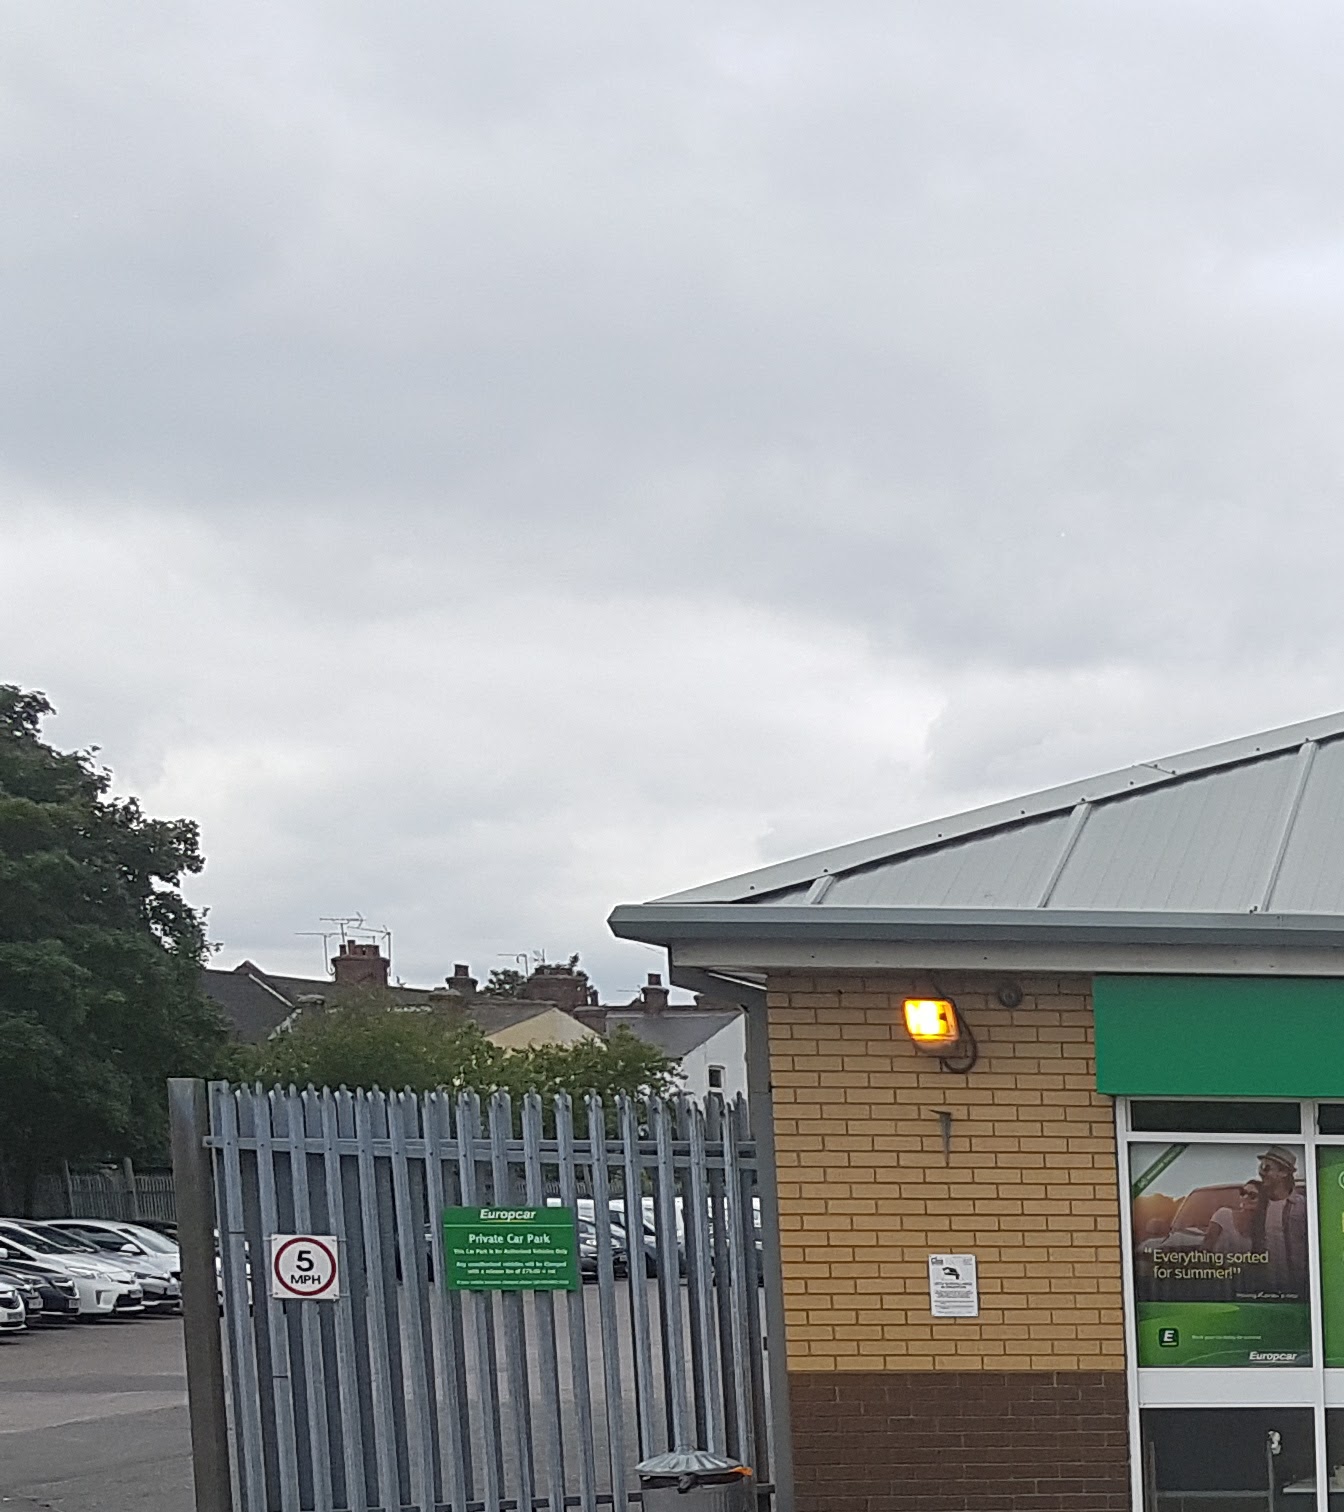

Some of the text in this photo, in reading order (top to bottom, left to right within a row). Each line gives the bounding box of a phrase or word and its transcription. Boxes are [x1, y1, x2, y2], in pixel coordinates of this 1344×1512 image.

[480, 1209, 536, 1221] Europcar
[469, 1233, 551, 1244] Private Car Park
[296, 1250, 314, 1272] 5
[1226, 1250, 1269, 1264] sorted
[1153, 1266, 1171, 1279] for
[290, 1274, 321, 1285] MPH
[1163, 1330, 1175, 1342] E
[1249, 1351, 1298, 1362] Europcar
